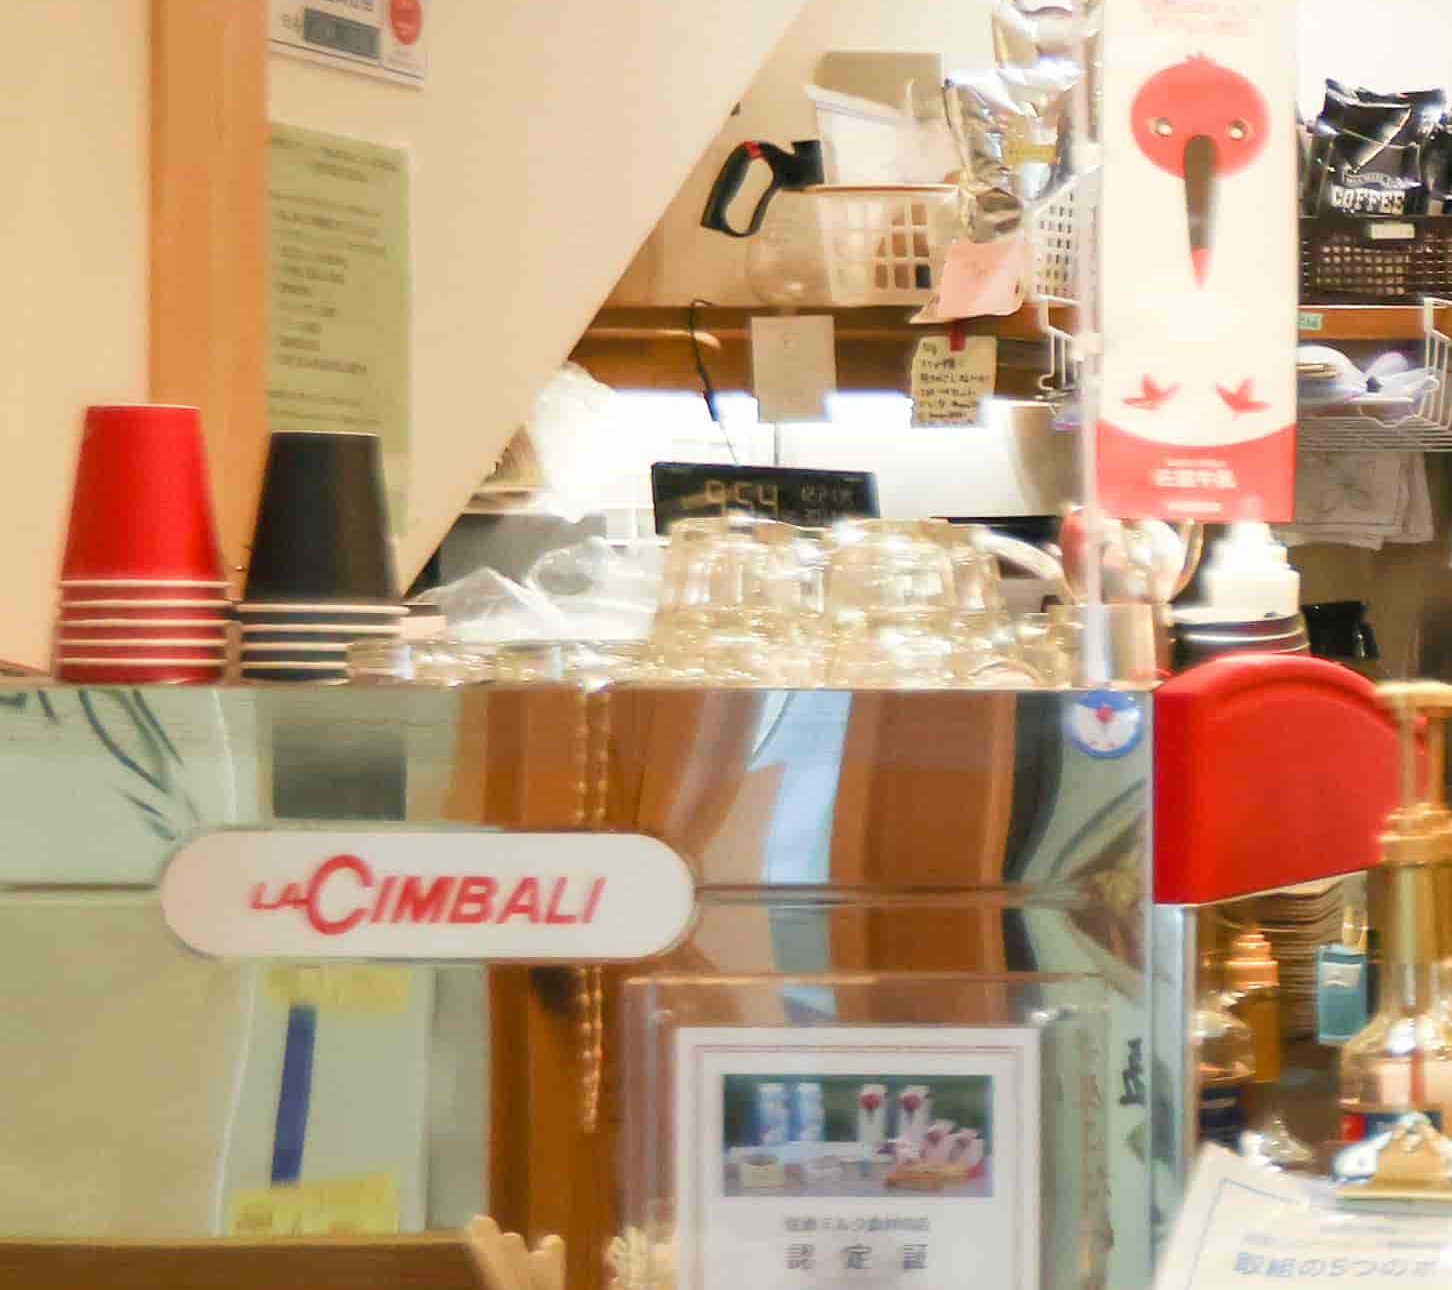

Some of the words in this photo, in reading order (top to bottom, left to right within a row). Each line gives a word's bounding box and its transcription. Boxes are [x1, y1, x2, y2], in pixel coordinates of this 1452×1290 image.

[1331, 185, 1406, 215] COFFEE
[306, 854, 606, 935] CIMBALI
[787, 1243, 928, 1270] 認定証
